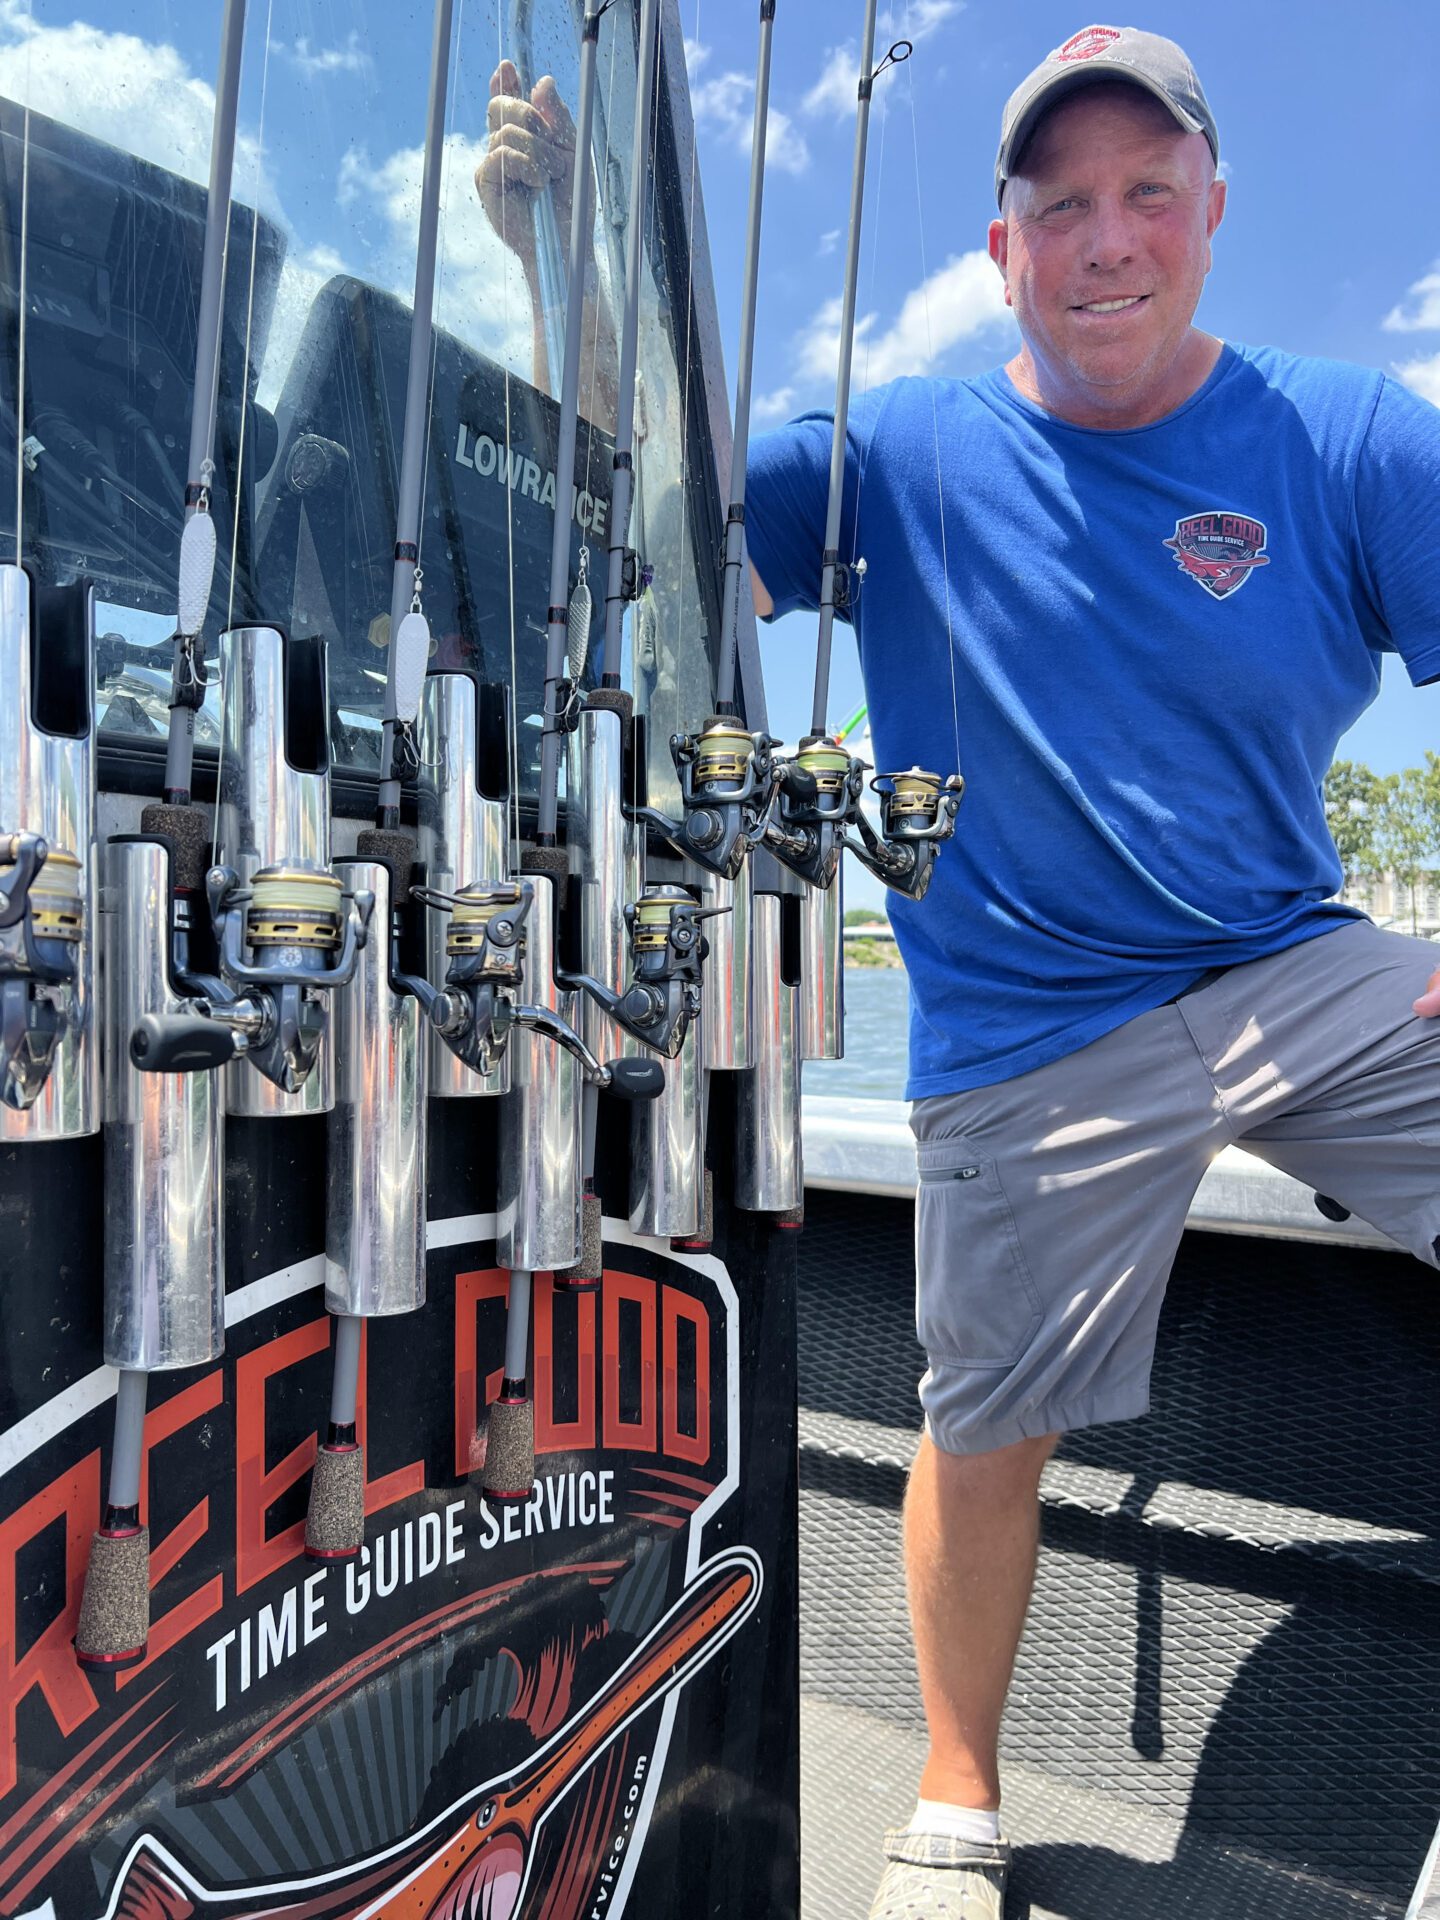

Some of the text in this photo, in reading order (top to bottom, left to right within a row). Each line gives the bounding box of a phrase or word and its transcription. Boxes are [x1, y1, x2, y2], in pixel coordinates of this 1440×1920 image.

[455, 423, 609, 536] LOWRACE
[1181, 516, 1263, 546] REEL GOOD
[1224, 536, 1245, 547] SERVICE
[206, 1469, 615, 1713] TIME GUIDE SERVICE
